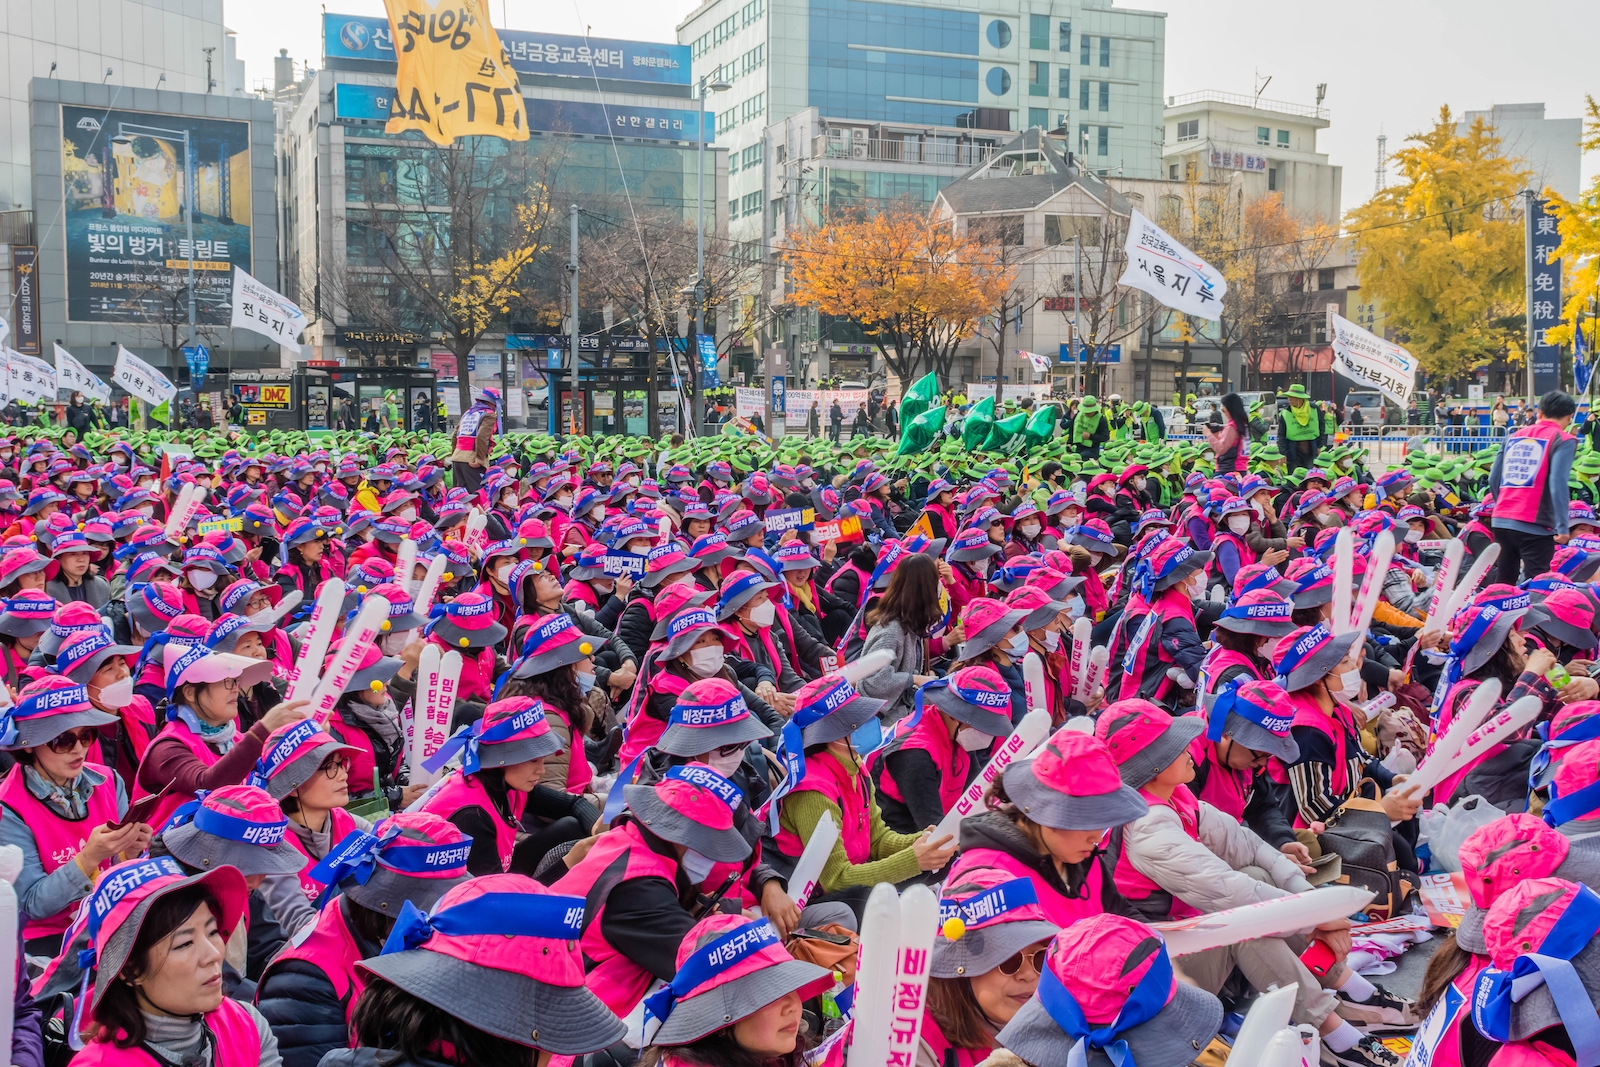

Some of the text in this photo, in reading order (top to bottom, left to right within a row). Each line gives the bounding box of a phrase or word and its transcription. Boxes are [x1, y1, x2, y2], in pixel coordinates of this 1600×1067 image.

[632, 56, 680, 70] 광화문캠퍼스
[615, 114, 683, 131] 신한갤러리
[88, 234, 230, 258] 빛의 벙커 클림트
[90, 272, 114, 280] 20년간
[21, 276, 31, 334] KB국민은행
[230, 372, 247, 380] Seoul
[248, 372, 262, 381] City
[264, 388, 286, 401] DMZ
[766, 510, 802, 532] 비정규직
[604, 558, 643, 574] 비정규직
[457, 602, 486, 616] 비정규직
[1247, 605, 1284, 616] 비정규직
[672, 612, 706, 632] 비정규직
[67, 636, 107, 660] 비정규직
[36, 689, 81, 710] 비정규직
[682, 705, 727, 724] 비정규직
[271, 722, 312, 765] 비정규직
[679, 766, 736, 797] 비정규직
[956, 734, 1025, 816] 임단협 승리
[426, 848, 463, 865] 비정규직
[94, 859, 162, 917] 비정규직
[708, 929, 760, 966] 비정규직
